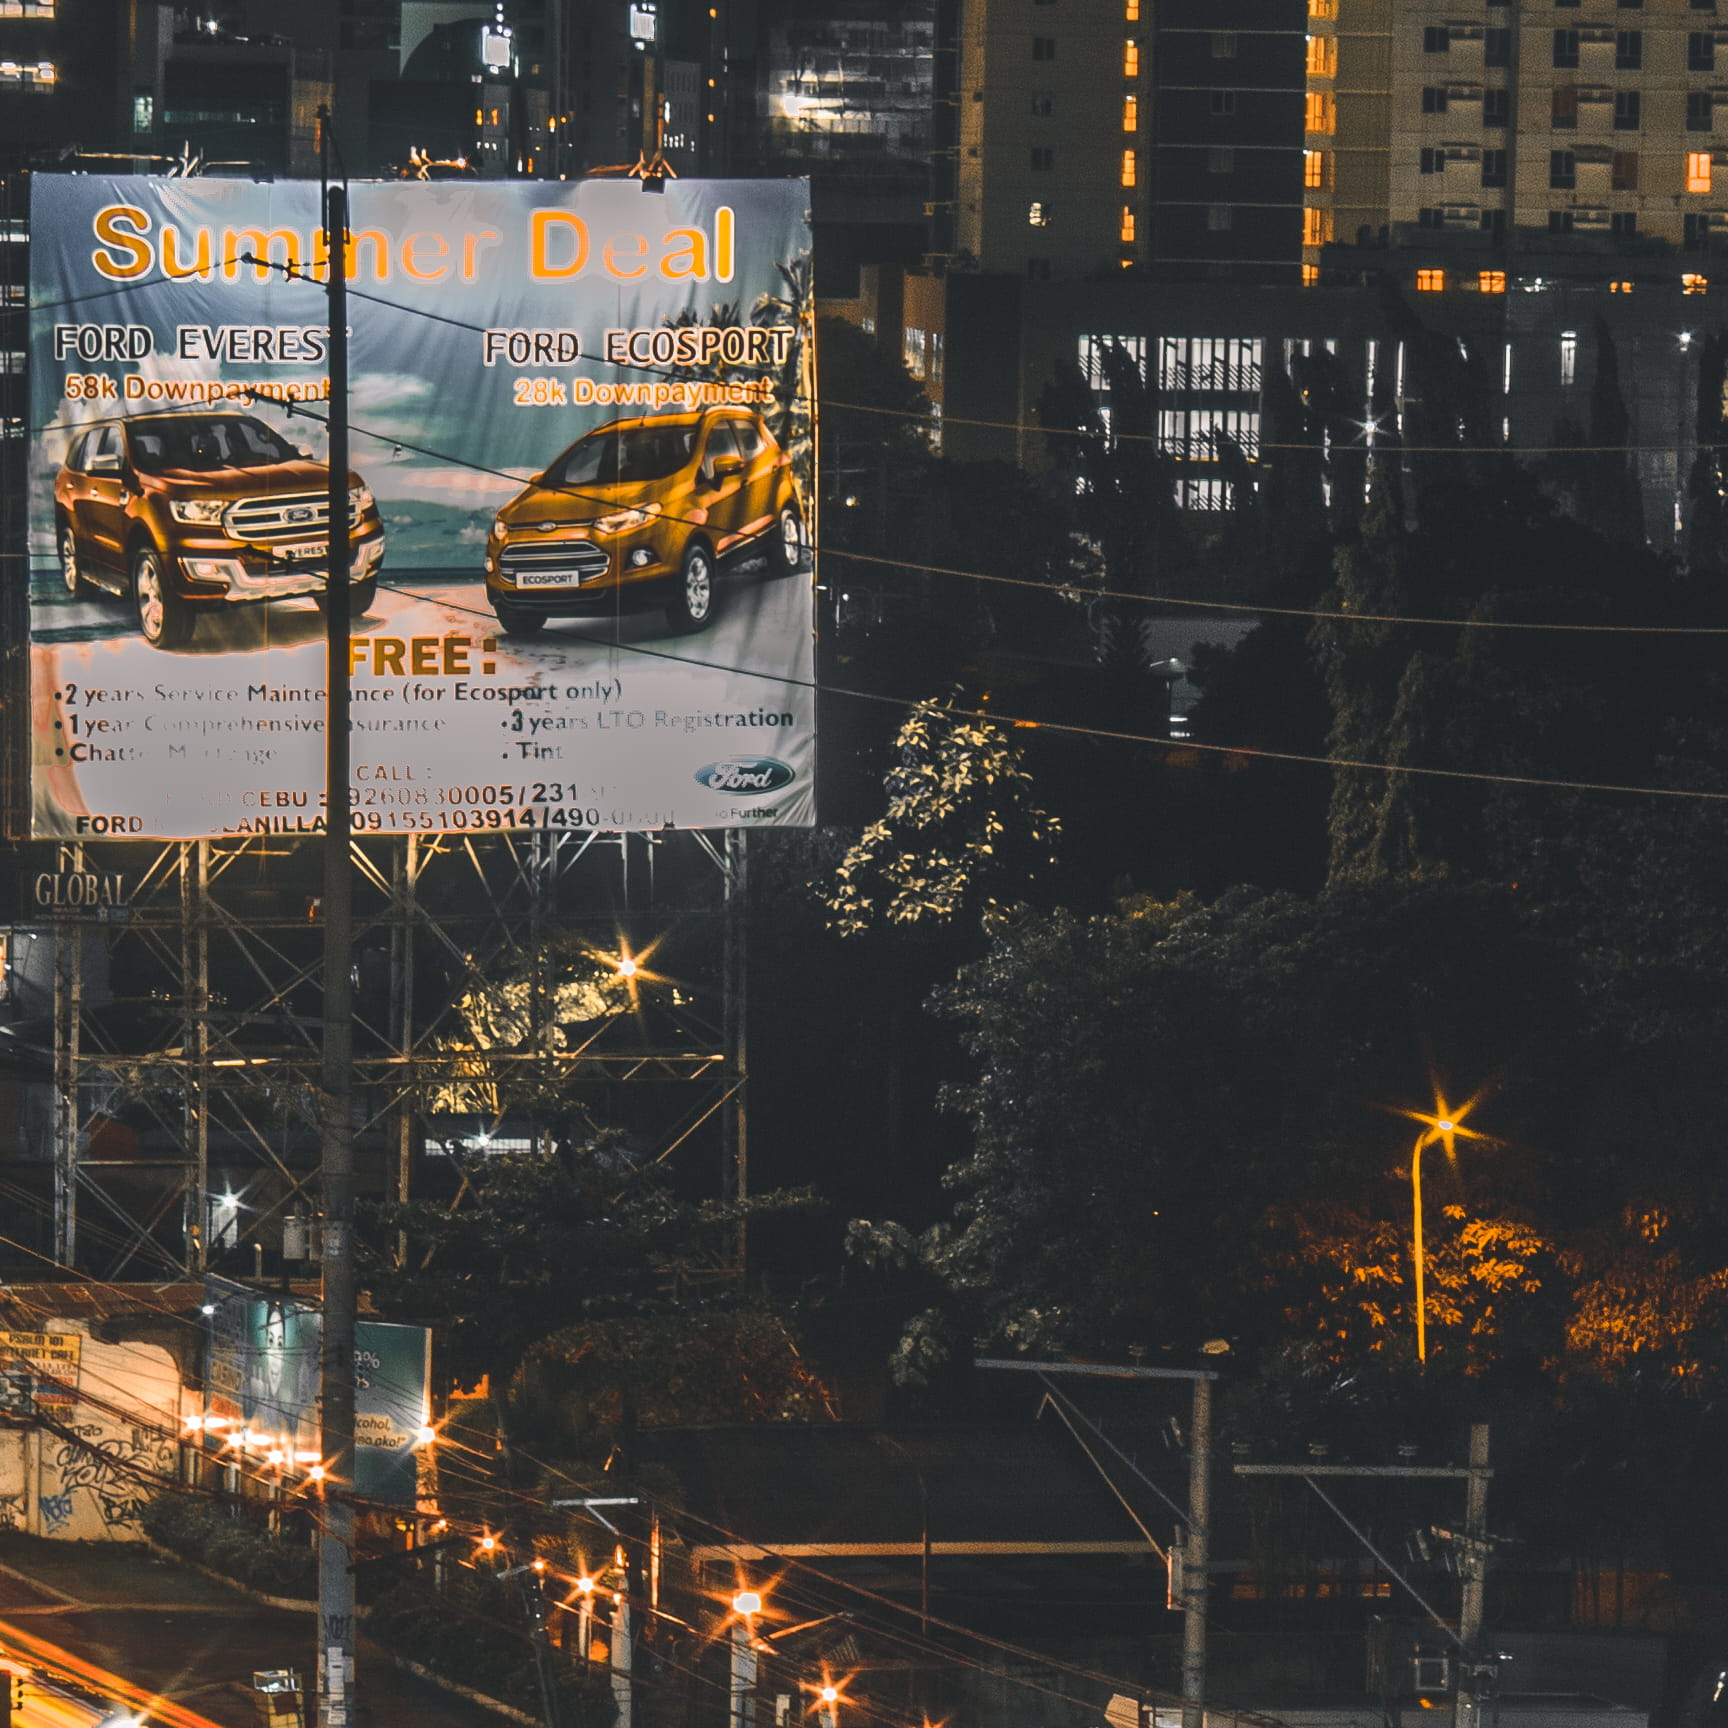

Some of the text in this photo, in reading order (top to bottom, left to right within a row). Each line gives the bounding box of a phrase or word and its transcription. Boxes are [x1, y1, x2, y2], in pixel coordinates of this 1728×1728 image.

[92, 205, 736, 282] Summer Deal
[56, 326, 353, 361] FORD EVERES
[486, 329, 793, 363] FORD ECOSPORT
[65, 374, 331, 407] 58k Downpayment
[514, 377, 775, 408] 28k Downpayment
[522, 574, 573, 586] ECOSPORT
[348, 636, 497, 677] FREE:
[65, 683, 78, 706] 2
[247, 683, 395, 704] Maintence
[403, 682, 446, 705] (for
[454, 681, 557, 706] Ecosport
[566, 678, 622, 703] only)
[511, 709, 524, 732] 3
[654, 707, 795, 733] Registration
[515, 741, 565, 760] Tint
[356, 765, 418, 781] CALL
[708, 762, 773, 790] Ford
[241, 790, 308, 808] CEBU
[76, 815, 144, 834] FORD
[35, 872, 129, 906] GLOBAL
